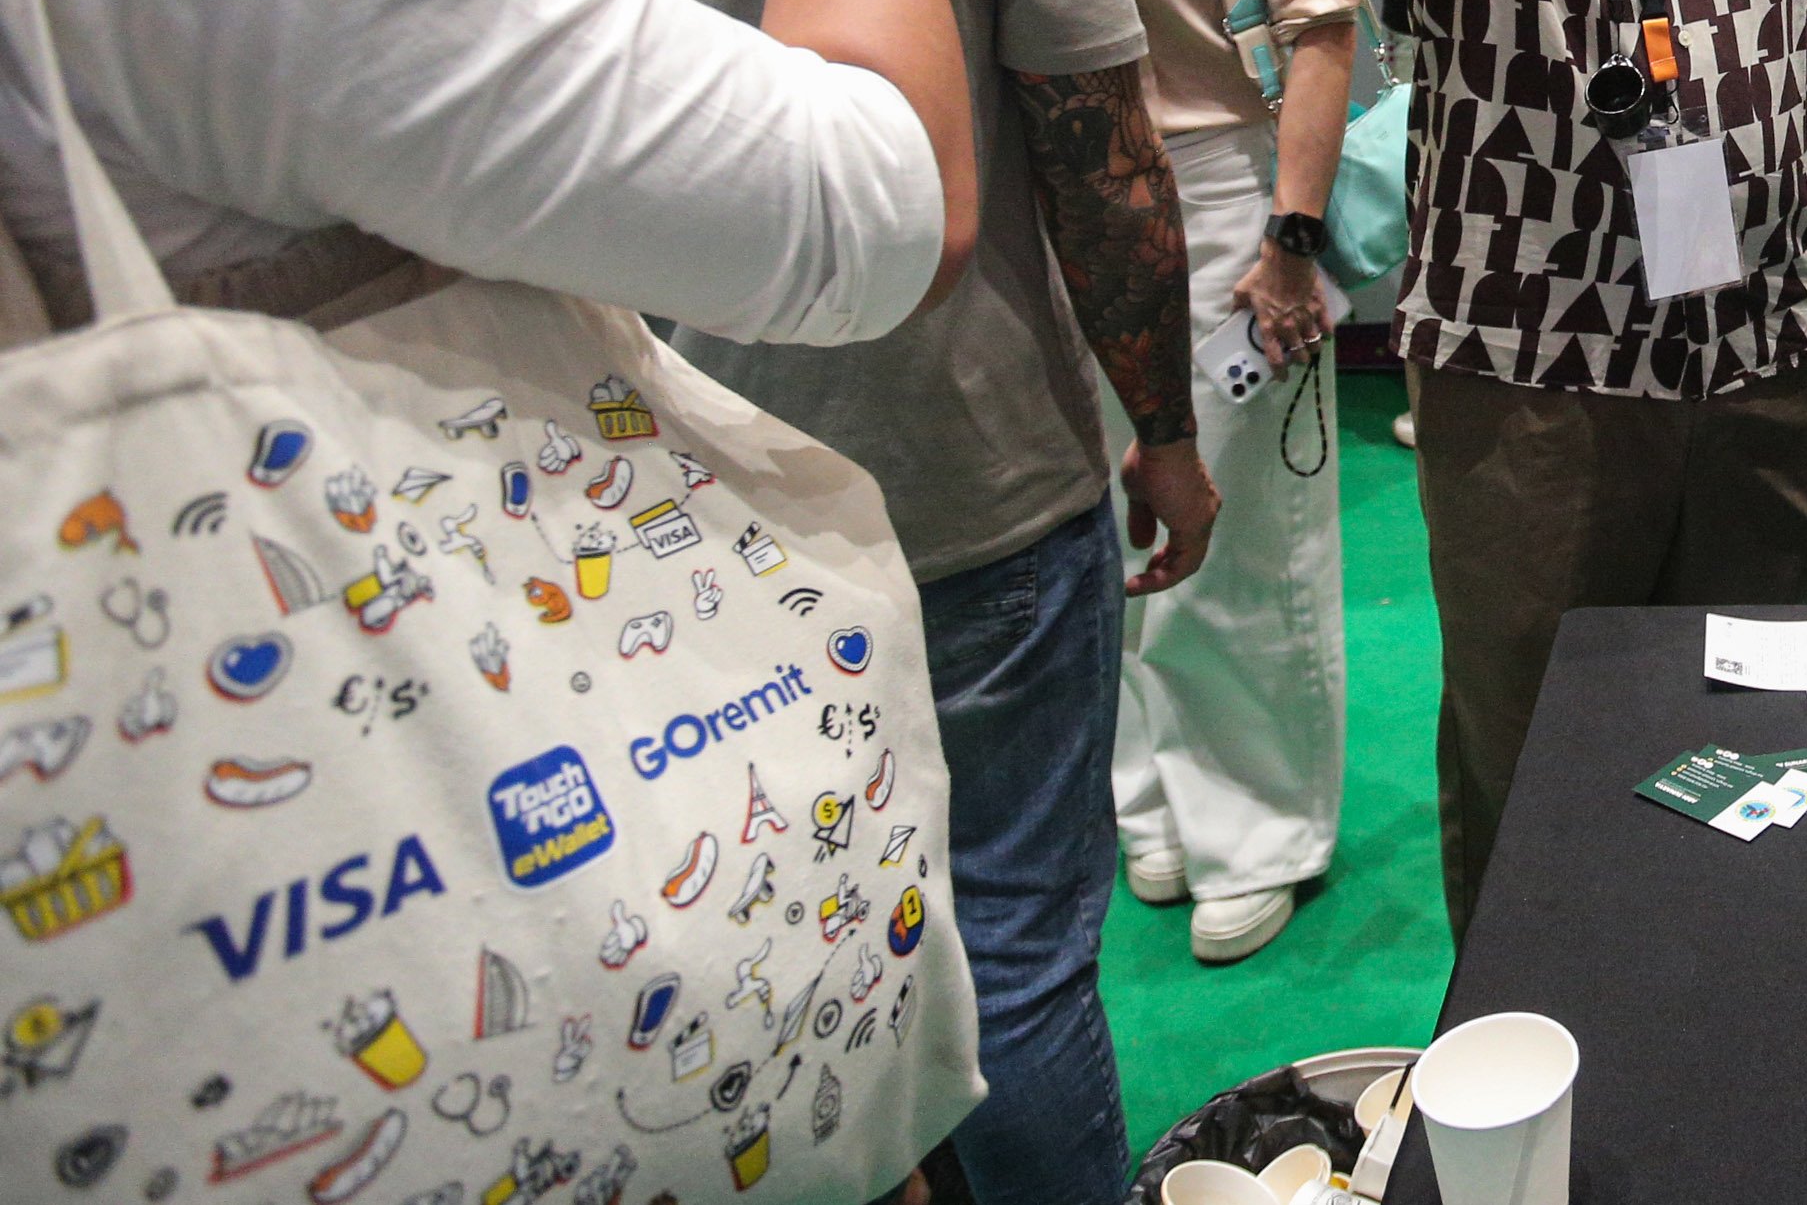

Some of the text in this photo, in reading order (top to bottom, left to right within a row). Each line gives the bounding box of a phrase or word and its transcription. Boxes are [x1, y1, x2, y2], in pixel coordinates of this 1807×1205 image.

[647, 525, 694, 549] VISA
[629, 663, 813, 781] GOremit
[493, 761, 587, 820] Touch
[182, 833, 448, 983] VISA
